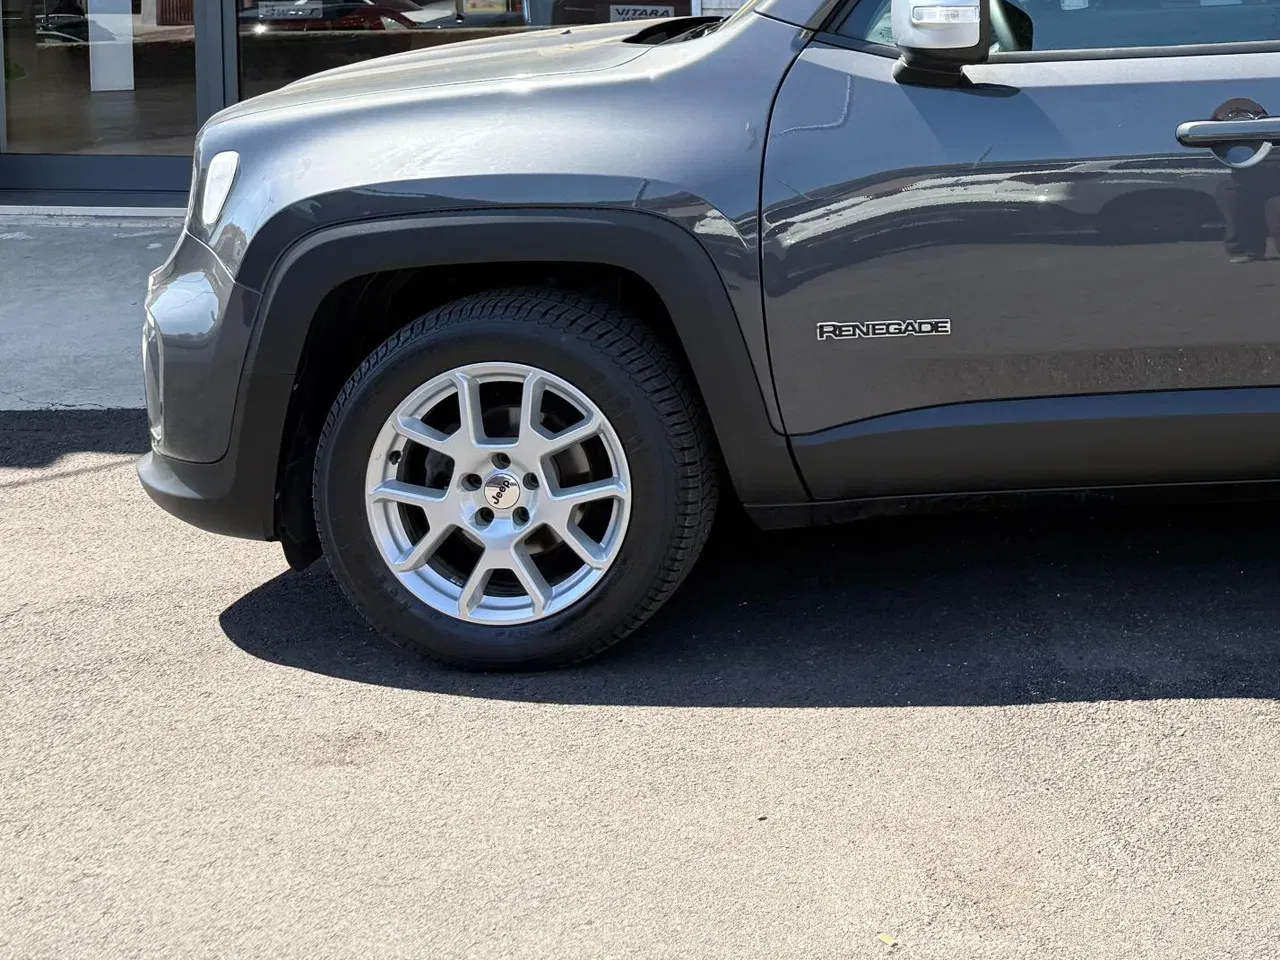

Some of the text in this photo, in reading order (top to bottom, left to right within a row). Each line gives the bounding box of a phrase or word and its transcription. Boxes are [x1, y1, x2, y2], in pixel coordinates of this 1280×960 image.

[615, 8, 669, 17] VITARA
[817, 319, 951, 340] RENEGADE
[491, 479, 511, 505] Jeep
